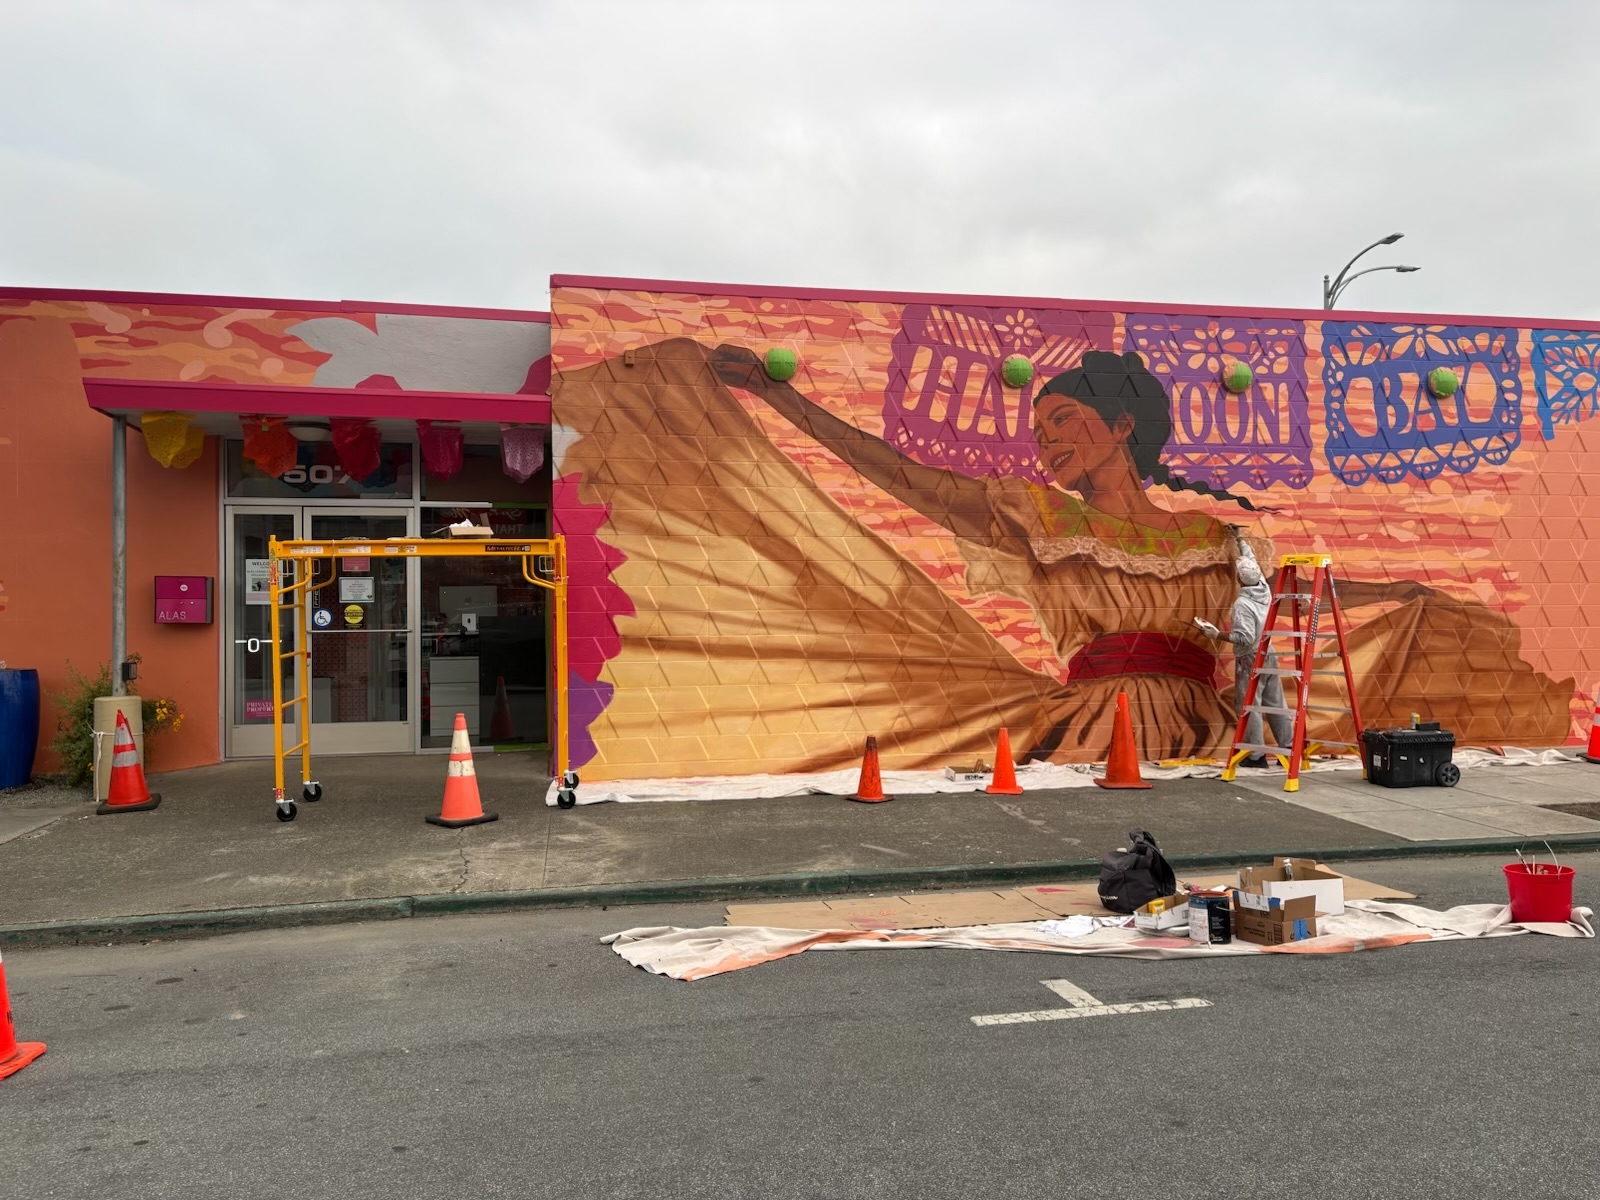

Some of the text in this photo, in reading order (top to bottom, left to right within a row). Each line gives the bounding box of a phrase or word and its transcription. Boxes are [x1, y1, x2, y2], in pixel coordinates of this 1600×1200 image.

[913, 346, 1039, 438] HAL
[1168, 382, 1288, 445] OON
[159, 611, 186, 620] ALAS
